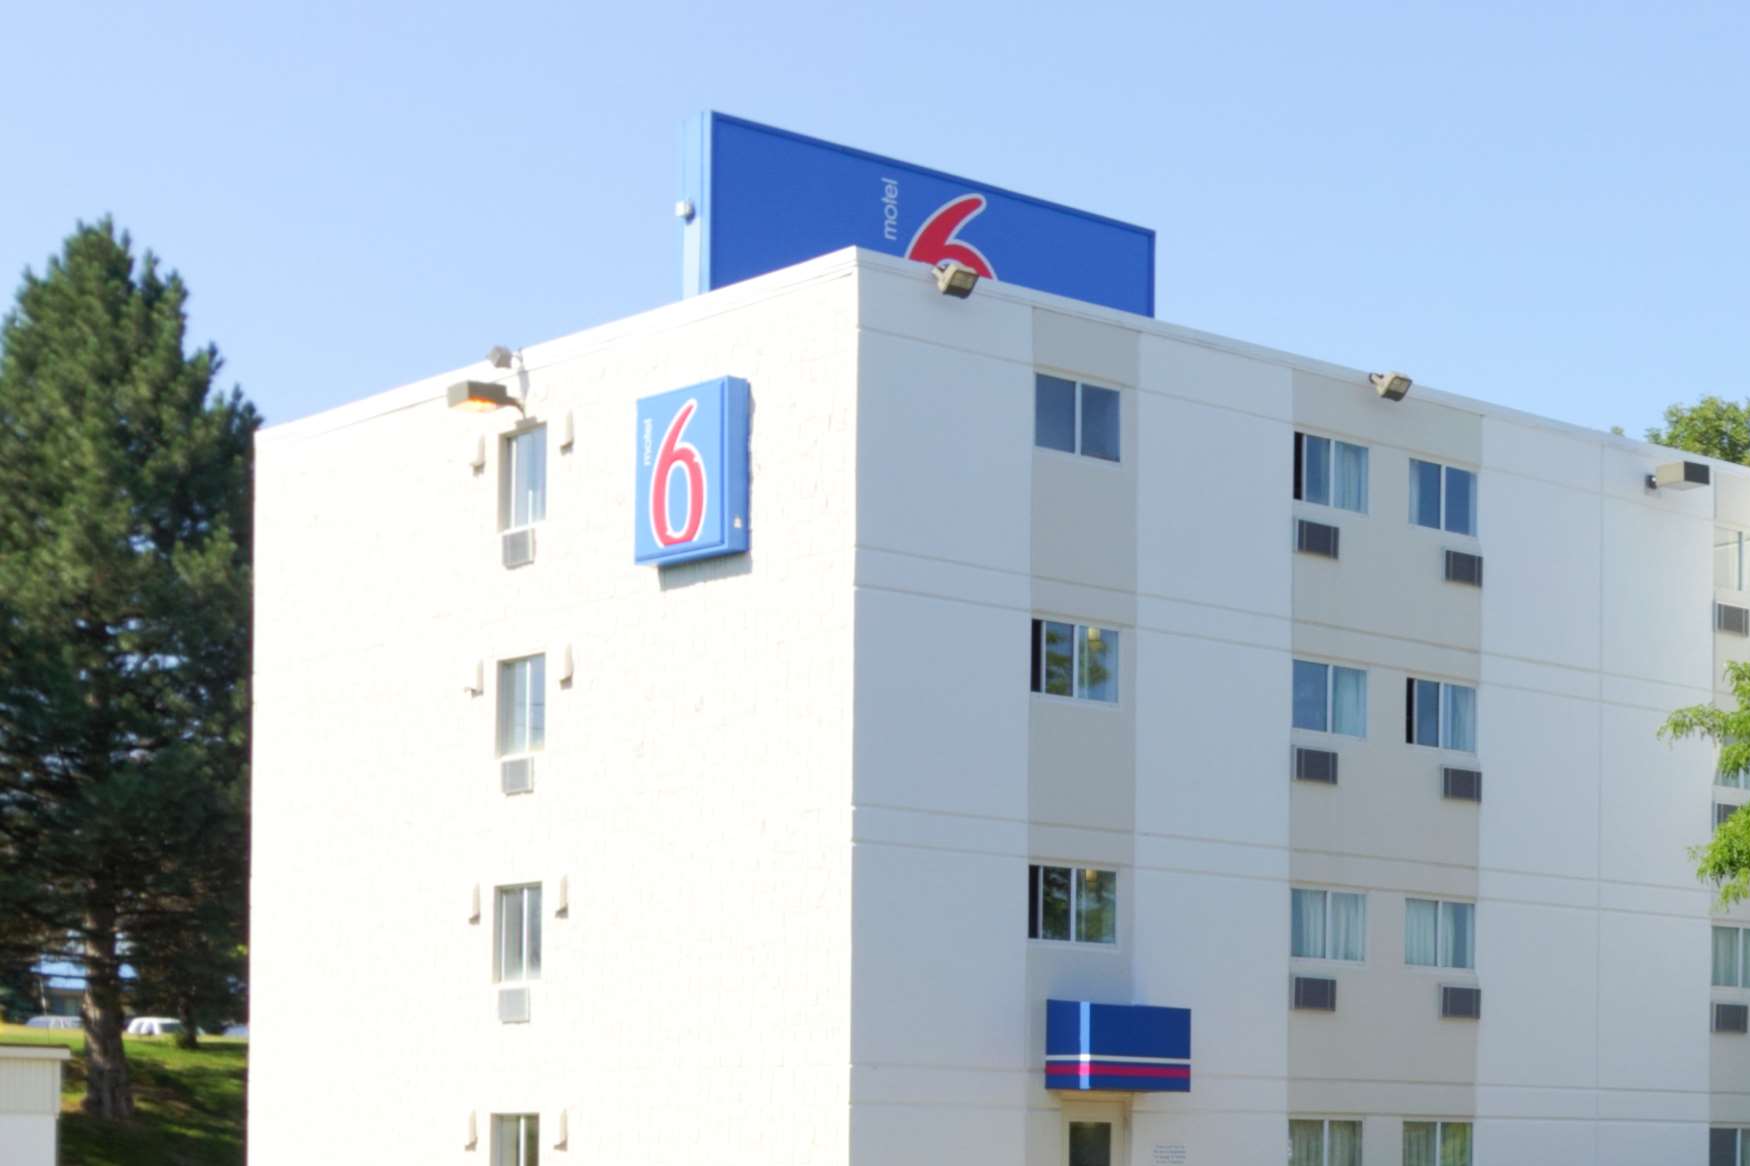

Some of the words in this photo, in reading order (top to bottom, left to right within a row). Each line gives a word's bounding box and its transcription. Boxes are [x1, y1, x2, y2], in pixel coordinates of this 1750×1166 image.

[881, 177, 898, 240] motel
[643, 418, 653, 466] motel
[650, 398, 707, 548] 6
